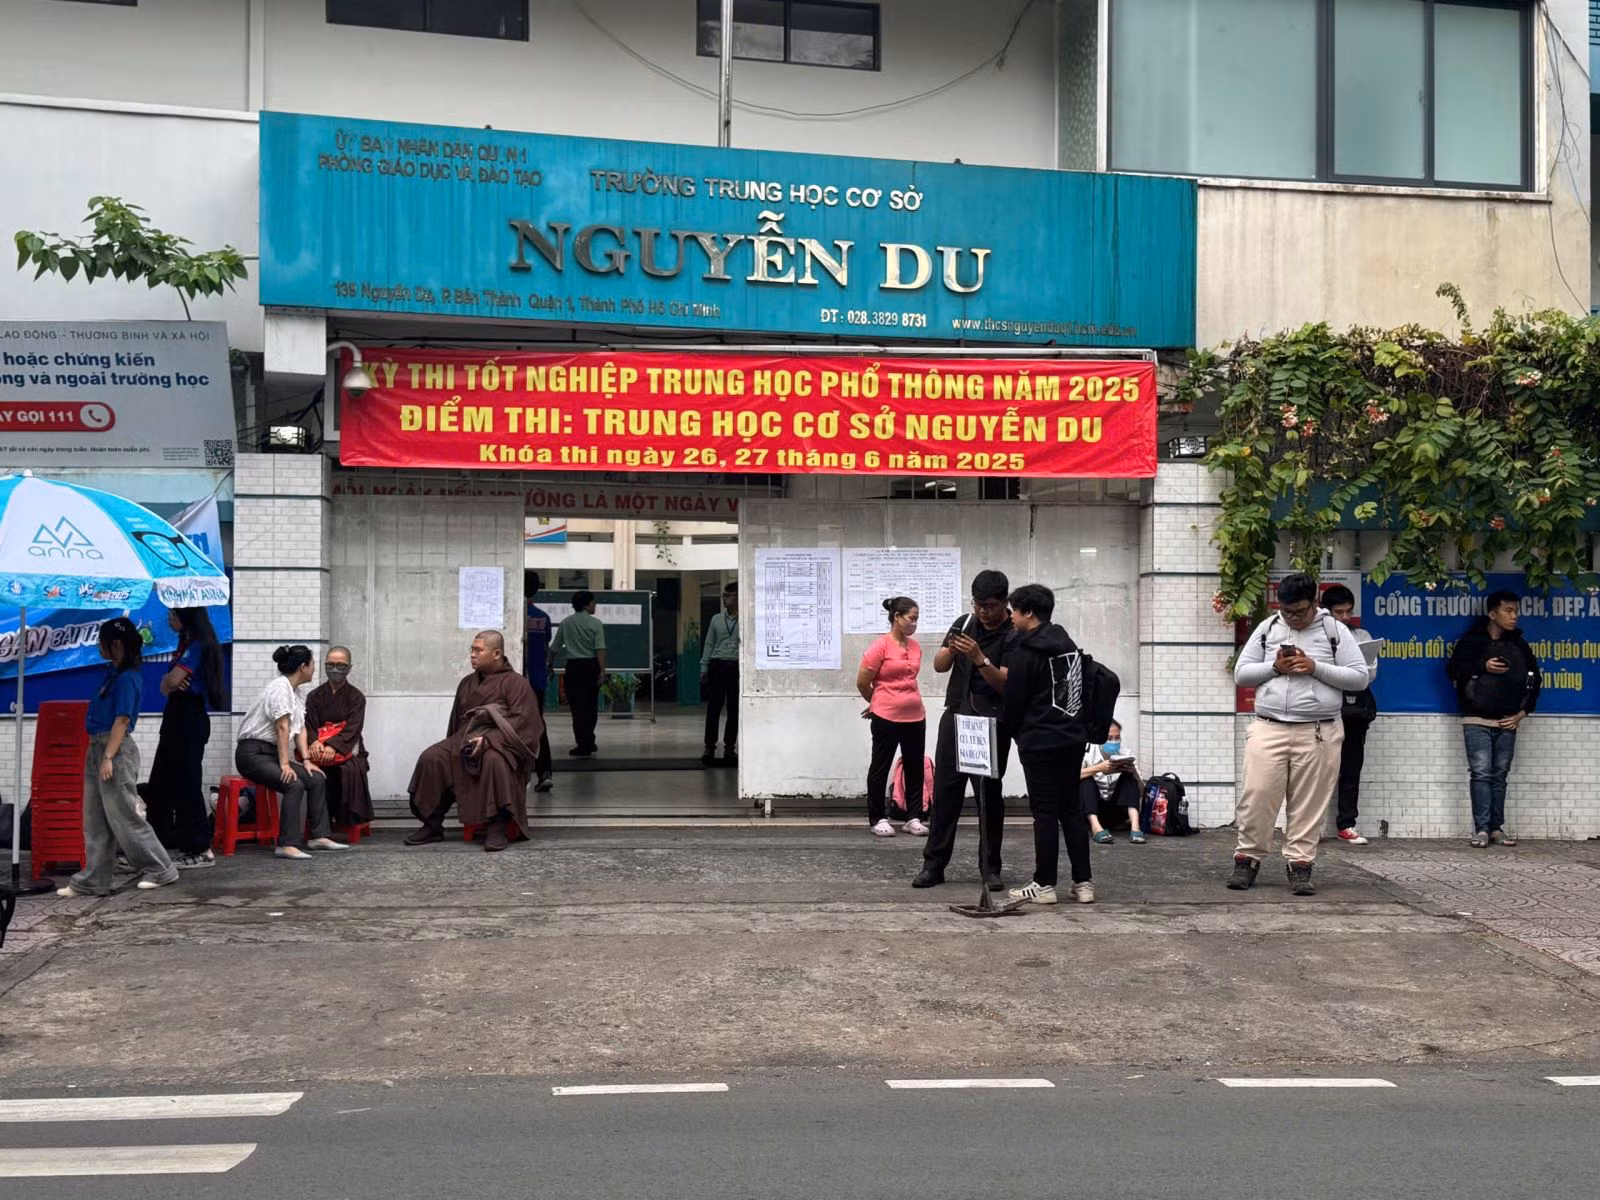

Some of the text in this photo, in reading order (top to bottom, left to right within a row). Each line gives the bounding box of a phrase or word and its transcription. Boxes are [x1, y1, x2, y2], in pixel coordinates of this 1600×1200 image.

[443, 140, 473, 159] DÂN
[319, 151, 543, 189] PHÒNG GIÁO DỤC VÀ ĐÀO TẠO
[590, 167, 923, 211] TRƯỜNG TRUNG HỌC CƠ SỞ
[509, 210, 991, 293] NGUYỄN DU
[529, 293, 562, 311] Quận
[693, 303, 721, 319] Minh
[847, 309, 899, 326] 028.3829
[901, 312, 927, 328] 8731
[23, 329, 58, 341] ĐỘNG
[69, 330, 118, 341] THƯƠNG
[190, 330, 210, 341] HỘI
[3, 351, 155, 369] hoặc chứng kiến
[29, 371, 51, 386] và
[55, 371, 107, 388] ngoài
[111, 371, 172, 389] trường
[175, 371, 210, 389] học
[361, 356, 1140, 403] KỲ THI TỐT NGHIỆP TRUNG HỌC PHỔ THÔNG NĂM 2025
[17, 410, 45, 424] GỌI
[48, 410, 73, 423] 111
[400, 394, 1103, 443] ĐIỂM THI: TRUNG HỌC CƠ SỞ NGUYỄN DU
[479, 443, 1025, 470] Khóa thi ngày 26, 27 tháng 6 năm 2025
[583, 489, 608, 510] LÀ
[615, 491, 658, 514] MỘT
[664, 492, 720, 512] NGÀY
[27, 545, 104, 560] anna
[1374, 589, 1422, 617] CỔNG
[1552, 596, 1585, 622] ĐẸP,
[1380, 634, 1423, 660] Chuyển
[1425, 635, 1445, 658] đổi
[1553, 638, 1580, 661] giáo
[1553, 667, 1583, 692] vững
